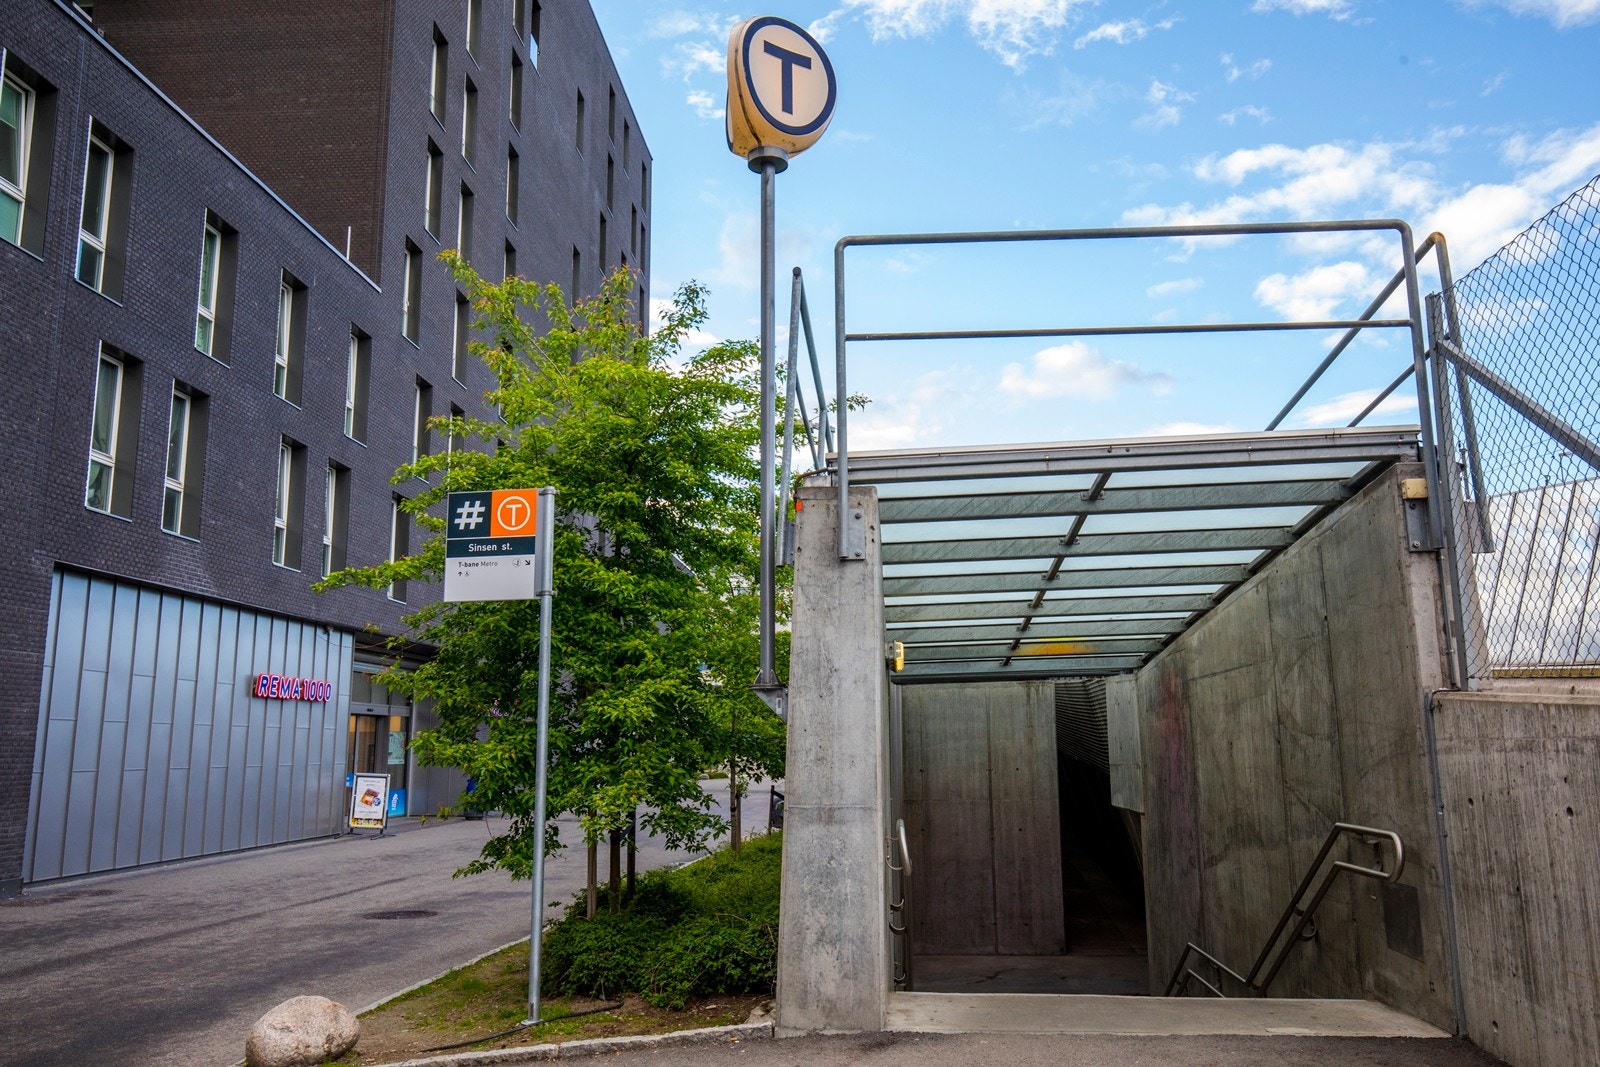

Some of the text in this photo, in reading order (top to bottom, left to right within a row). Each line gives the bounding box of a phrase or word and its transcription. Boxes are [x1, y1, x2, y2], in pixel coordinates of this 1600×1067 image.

[763, 39, 812, 116] T
[506, 504, 522, 526] T
[468, 542, 513, 552] Sinsen st.
[257, 674, 332, 701] REMA 1000
